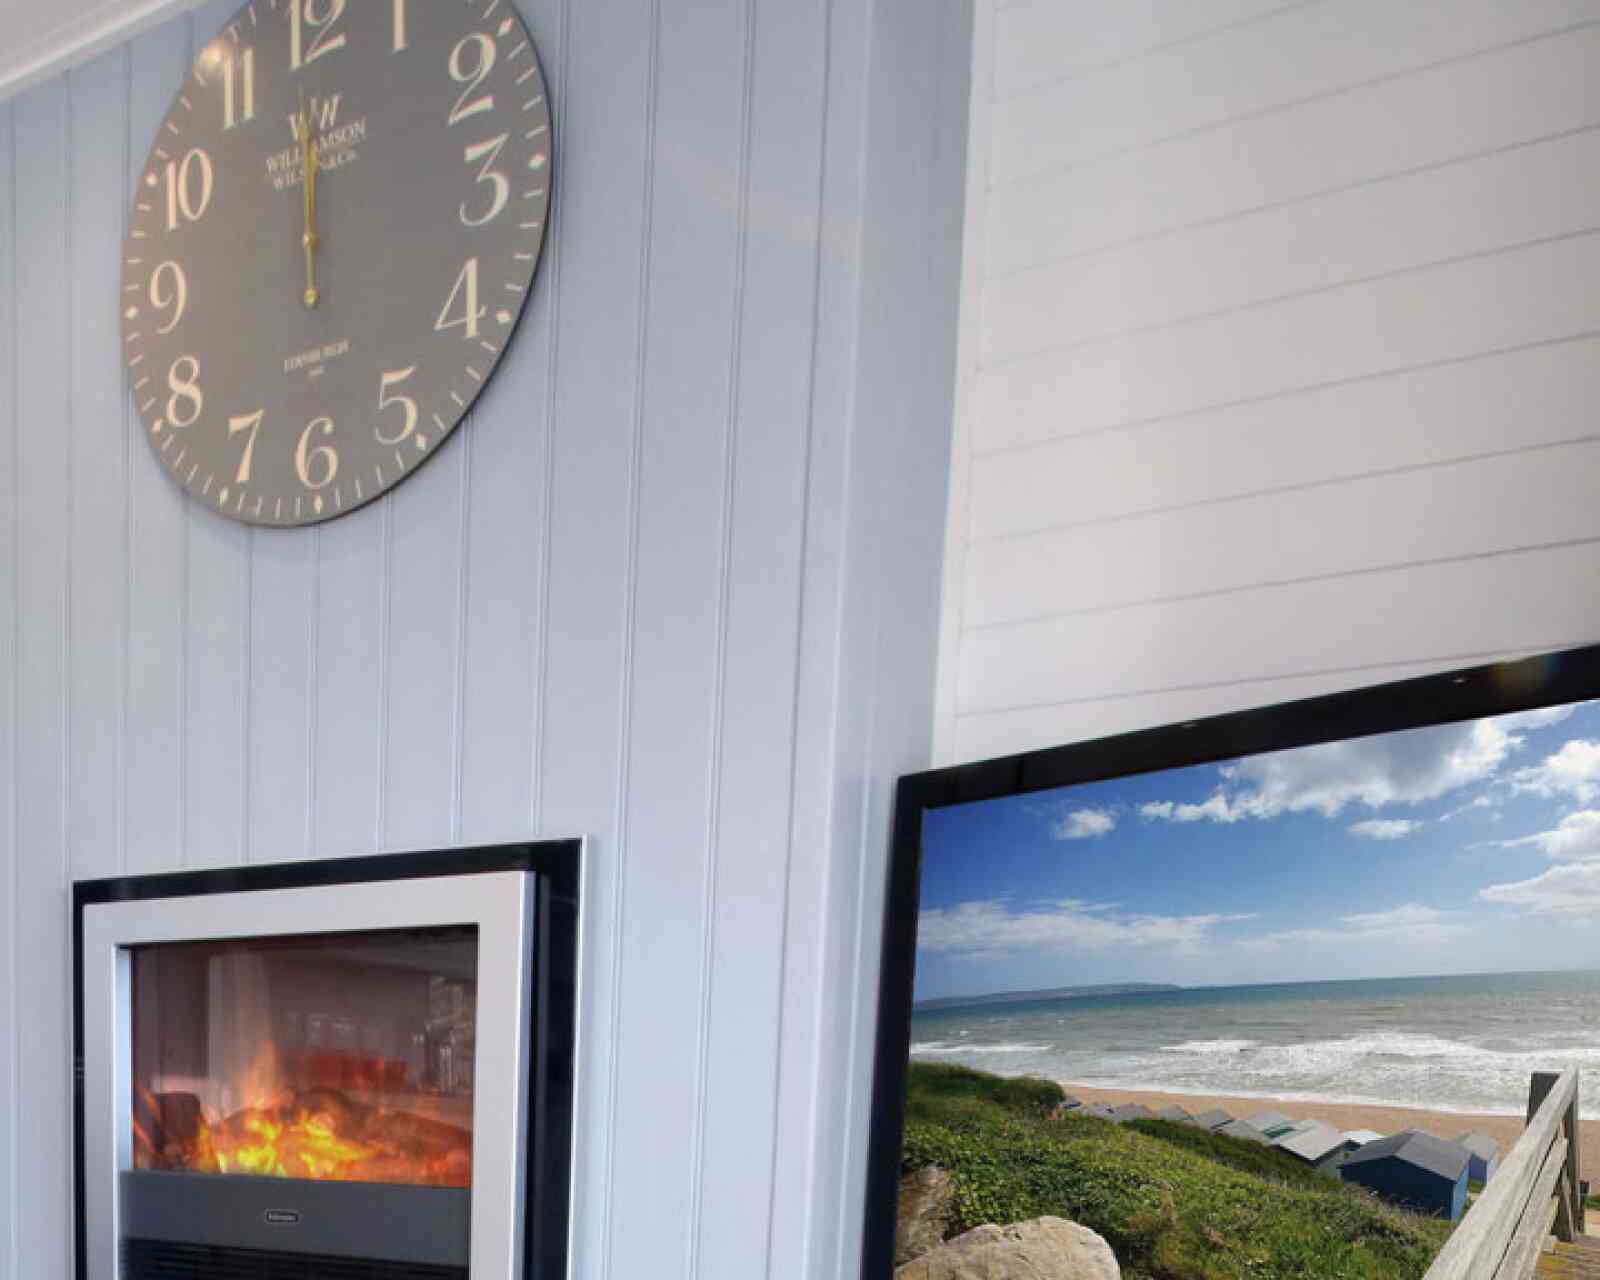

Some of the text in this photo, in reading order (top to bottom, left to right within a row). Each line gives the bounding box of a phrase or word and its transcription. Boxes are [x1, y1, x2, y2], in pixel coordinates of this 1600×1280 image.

[289, 0, 346, 70] 12
[221, 46, 256, 130] 11
[448, 32, 498, 127] 2
[165, 148, 214, 231] 10
[458, 132, 510, 227] 3
[149, 260, 187, 335] 9
[433, 257, 487, 340] 4
[166, 355, 204, 428] 8
[374, 364, 418, 446] 5
[228, 408, 265, 484] 7
[295, 417, 339, 490] 6
